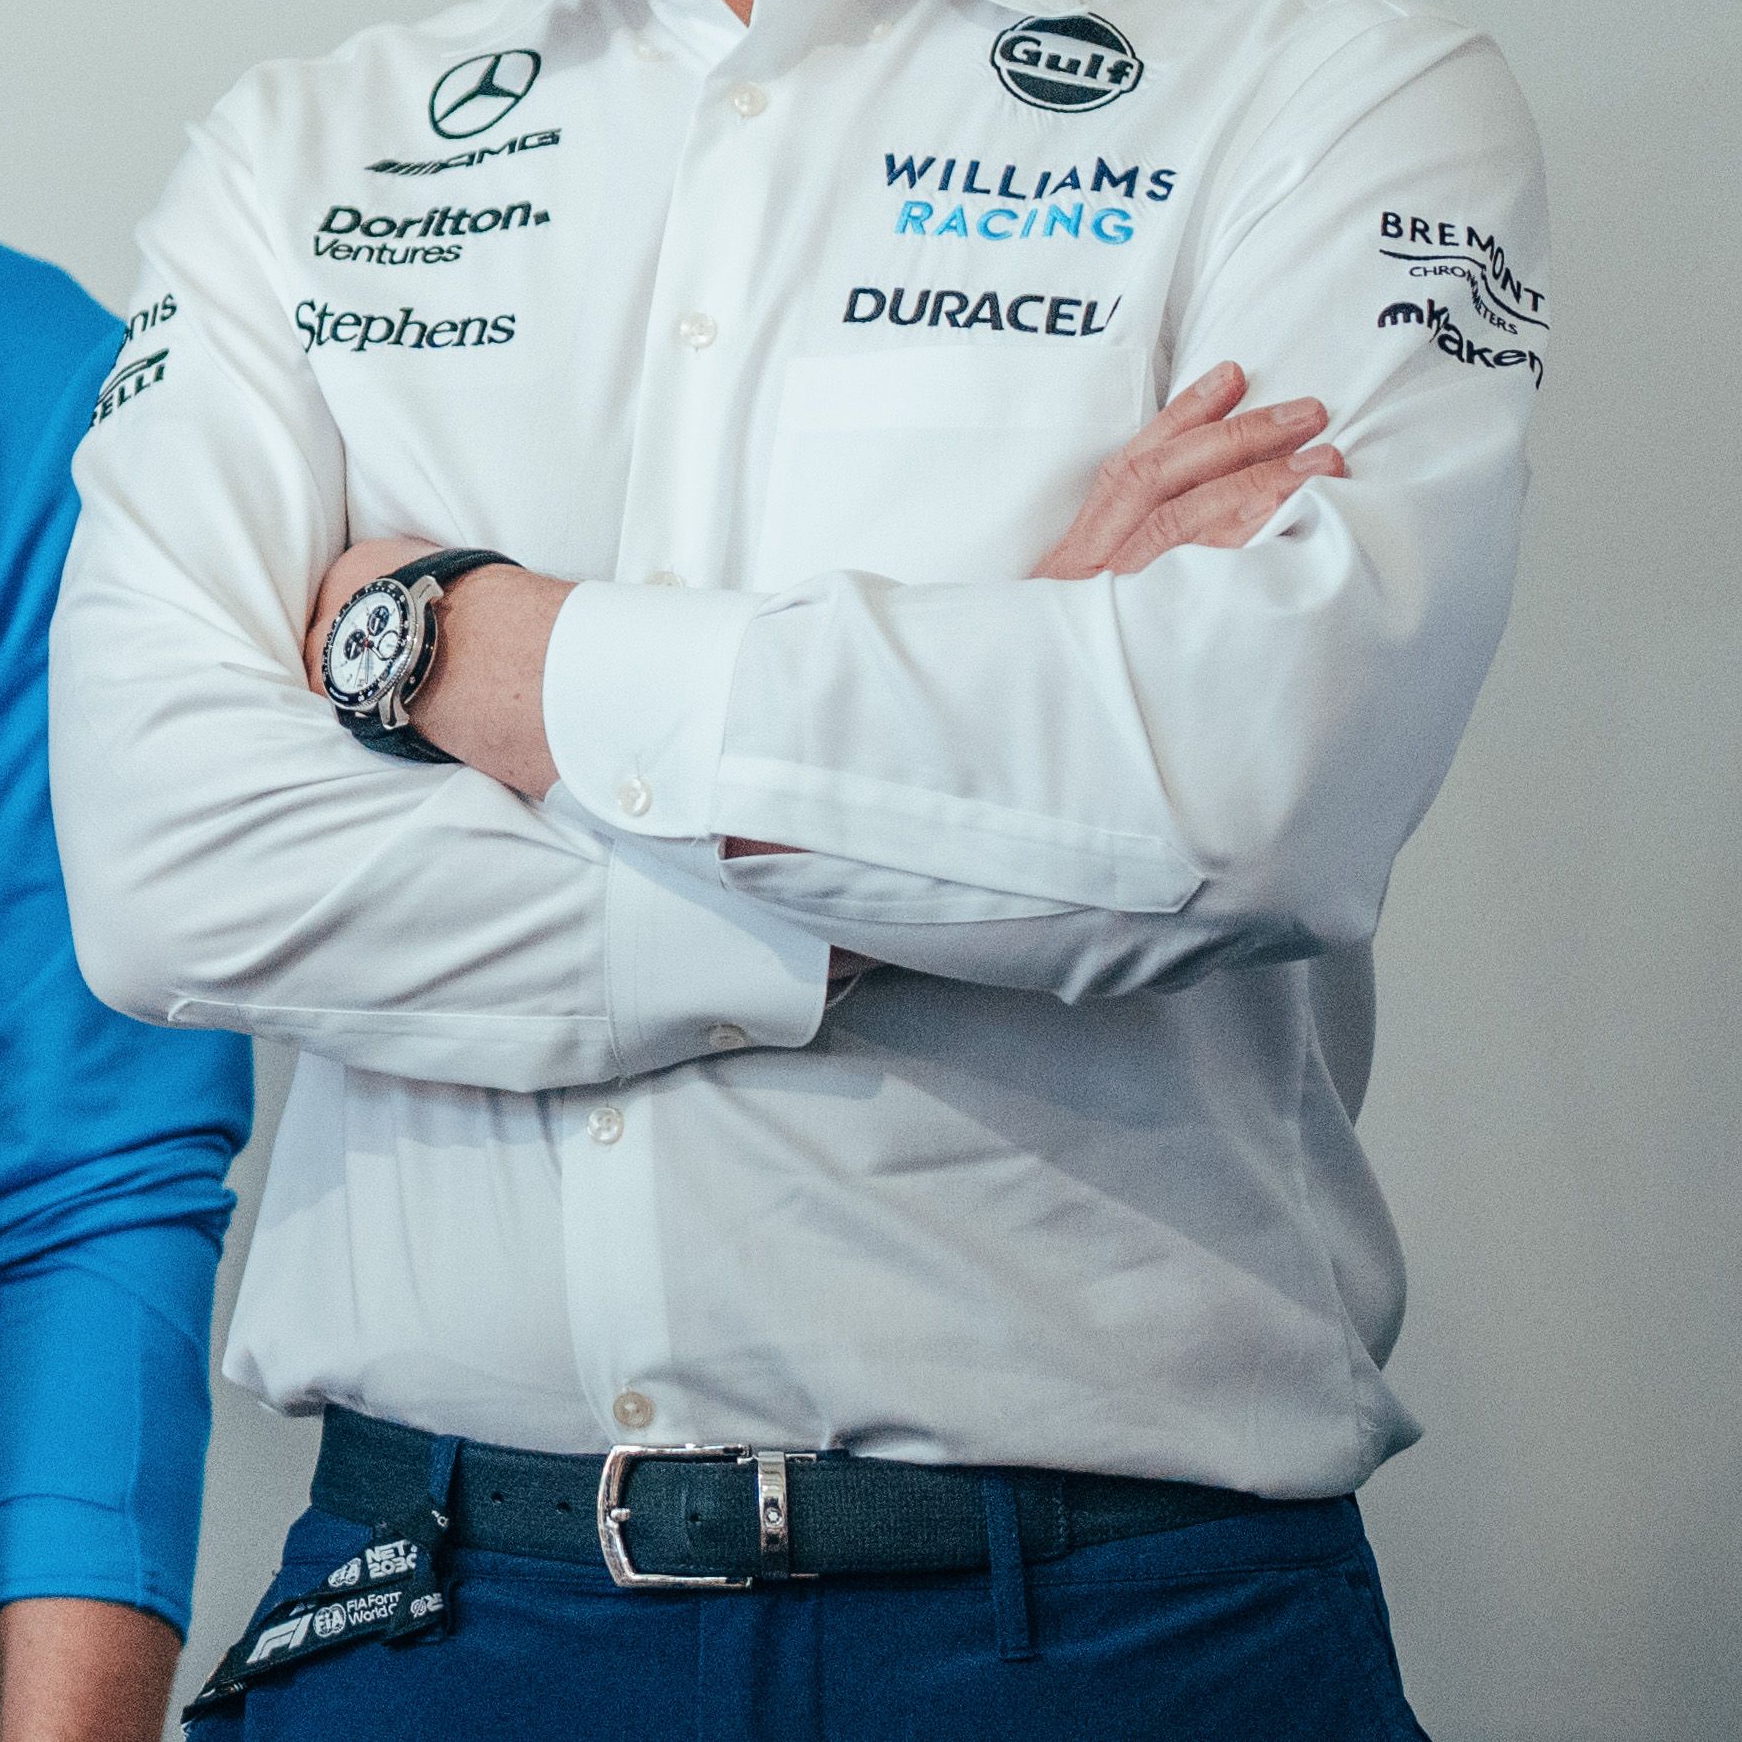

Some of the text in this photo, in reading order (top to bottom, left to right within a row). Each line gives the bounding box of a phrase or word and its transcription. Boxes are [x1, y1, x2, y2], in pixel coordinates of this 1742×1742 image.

[1000, 36, 1133, 85] Gulf
[434, 128, 562, 173] AMG
[886, 153, 1177, 202] WILLIAMS
[895, 200, 1135, 245] RACING
[313, 235, 463, 265] Ventures
[1381, 212, 1545, 312] BREMONT
[295, 299, 516, 354] Stephens
